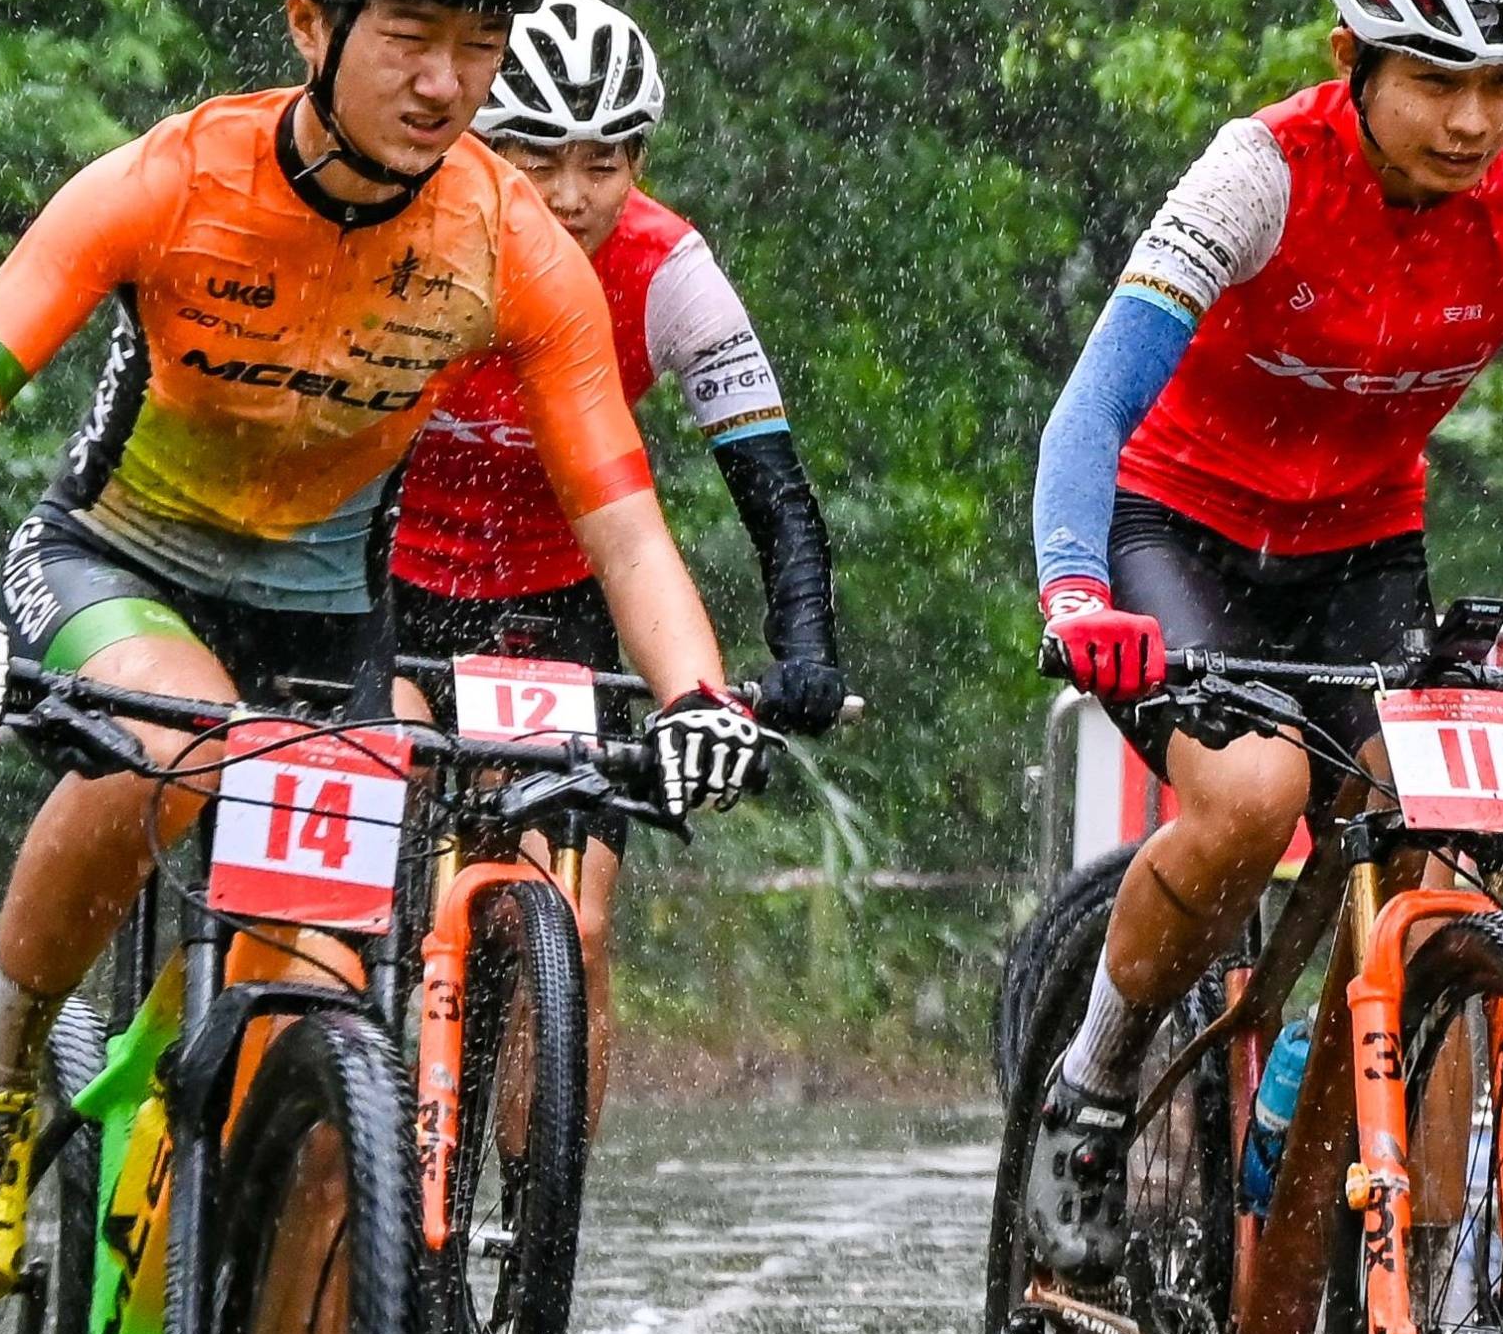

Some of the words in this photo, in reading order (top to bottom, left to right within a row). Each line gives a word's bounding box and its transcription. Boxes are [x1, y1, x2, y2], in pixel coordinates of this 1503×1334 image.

[495, 684, 558, 732] 12
[1438, 728, 1499, 790] 11
[266, 773, 353, 869] 14
